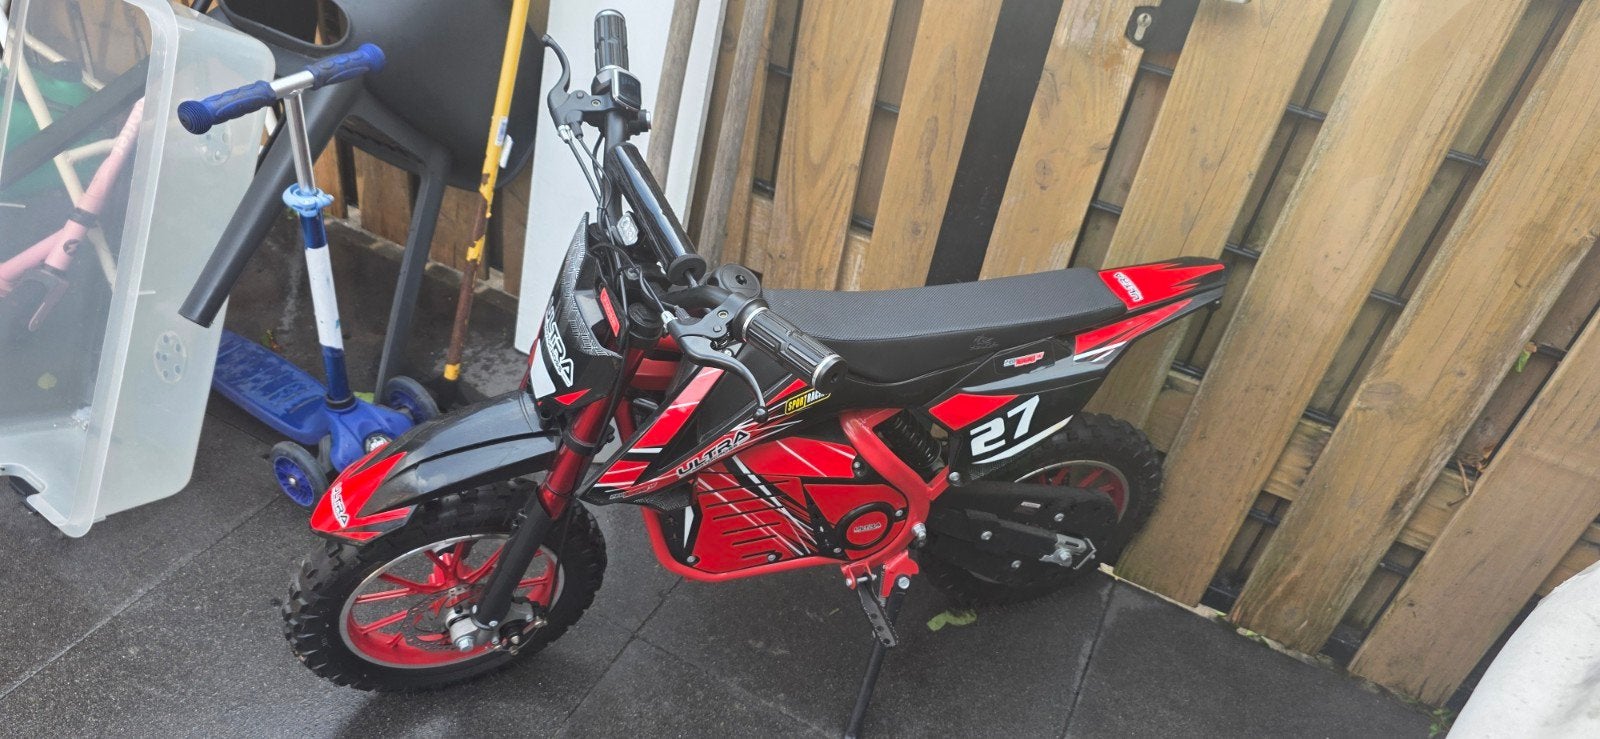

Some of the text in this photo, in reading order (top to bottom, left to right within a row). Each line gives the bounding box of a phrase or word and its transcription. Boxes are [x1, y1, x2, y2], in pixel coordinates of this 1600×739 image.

[1113, 271, 1144, 302] ULTRA
[787, 394, 808, 411] SPORT
[970, 394, 1040, 456] 27
[676, 430, 750, 476] ULTRA
[331, 482, 350, 528] ULTRA
